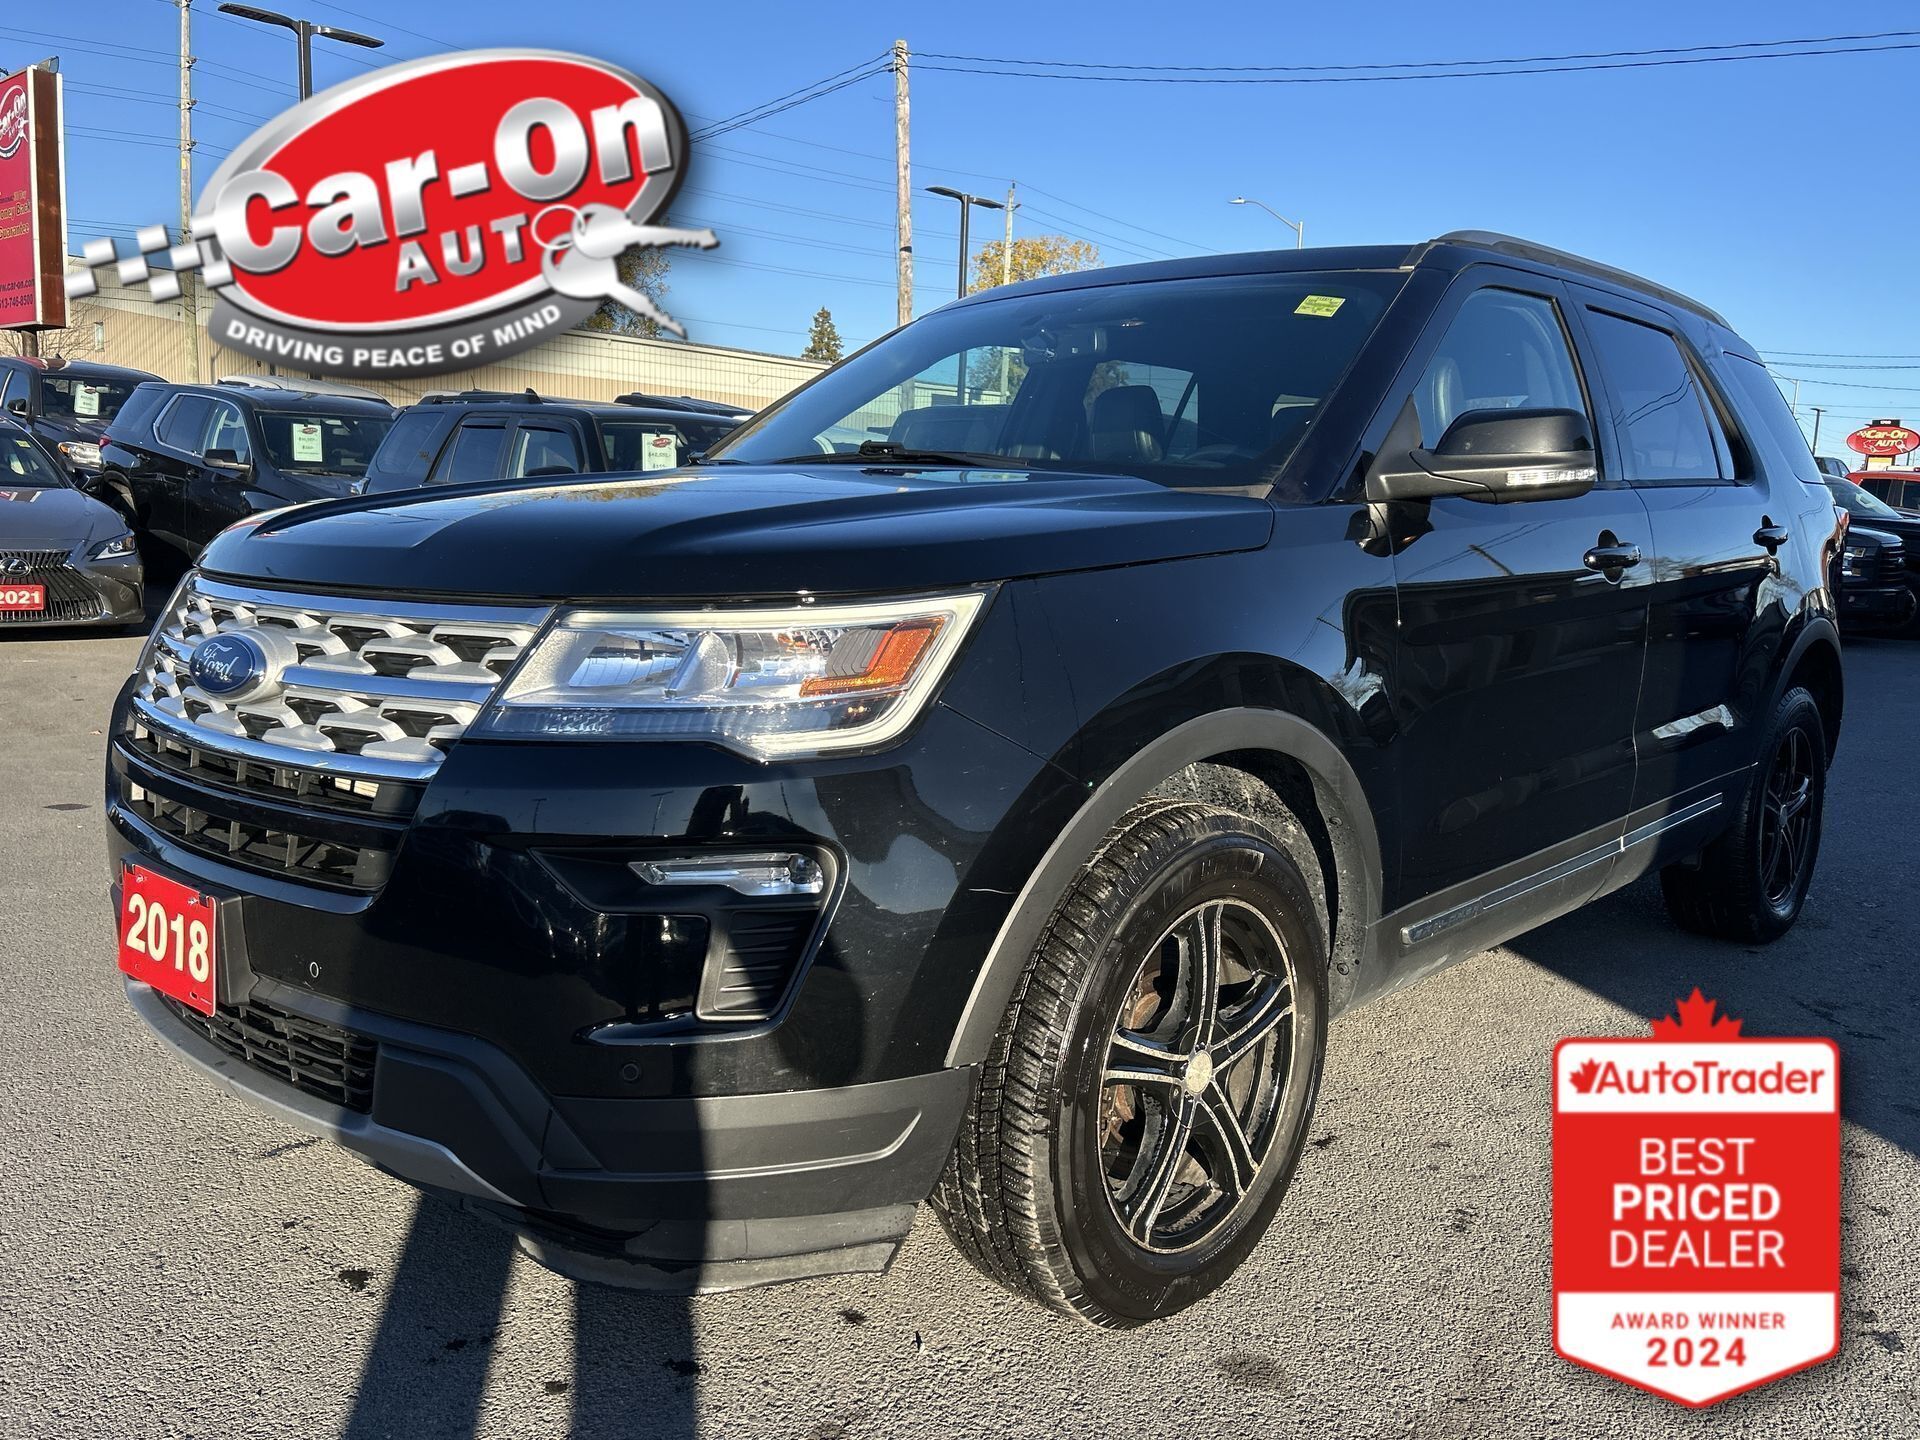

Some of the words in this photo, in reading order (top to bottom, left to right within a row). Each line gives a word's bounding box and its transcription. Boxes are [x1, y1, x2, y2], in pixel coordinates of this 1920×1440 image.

[0, 206, 15, 220] oney
[1866, 429, 1909, 439] Car-On
[0, 590, 40, 605] 2021
[196, 642, 239, 683] Ford
[126, 893, 210, 983] 2018
